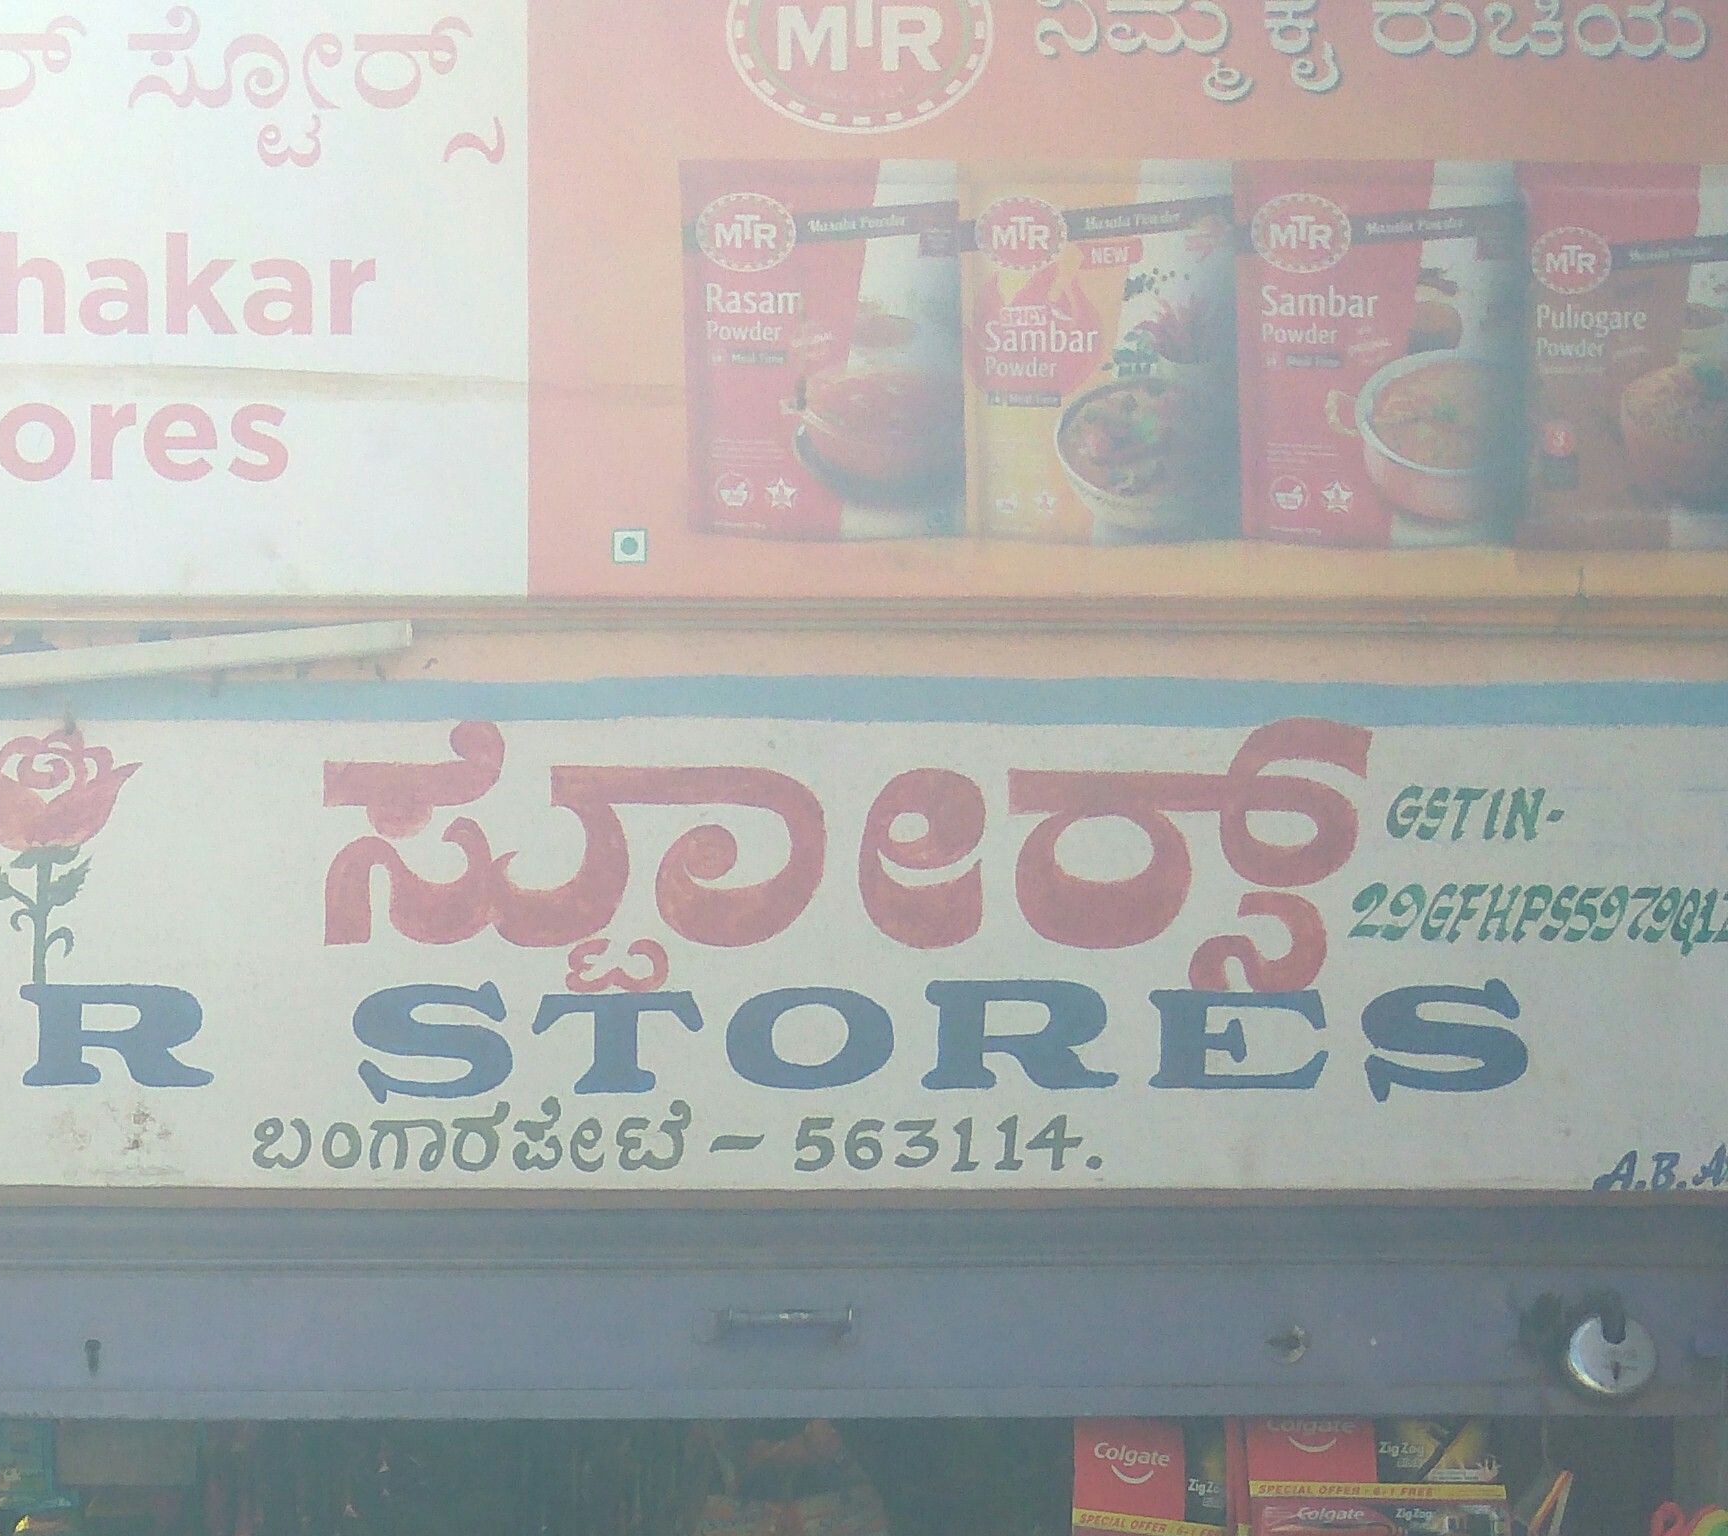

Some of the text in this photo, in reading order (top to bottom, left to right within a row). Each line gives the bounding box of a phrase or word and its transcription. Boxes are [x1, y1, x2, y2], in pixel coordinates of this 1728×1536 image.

[127, 3, 506, 168] ಸ್ಟೋರ್ಸ್
[714, 212, 777, 251] MTR
[991, 214, 1051, 250] MTR
[1268, 214, 1333, 250] MTR
[1090, 245, 1129, 265] NEW
[1545, 244, 1595, 276] MTR
[1260, 285, 1379, 319] Sambar
[706, 320, 783, 343] Powder
[1260, 322, 1339, 346] Powder
[1535, 302, 1649, 339] Puliogare
[984, 321, 1099, 354] Sambar
[1535, 336, 1605, 359] Powder
[984, 356, 1059, 379] Powder
[322, 716, 1373, 993] ಸ್ಟೋರ್ಸ್
[351, 978, 1530, 1104] STORES
[1093, 1441, 1171, 1468] Colgate
[1257, 1484, 1313, 1495] SPECIAL
[1317, 1484, 1362, 1496] OFFER
[1080, 1512, 1126, 1529] SPECIAL
[1129, 1518, 1167, 1533] OFFER
[1298, 1506, 1365, 1523] Colgate
